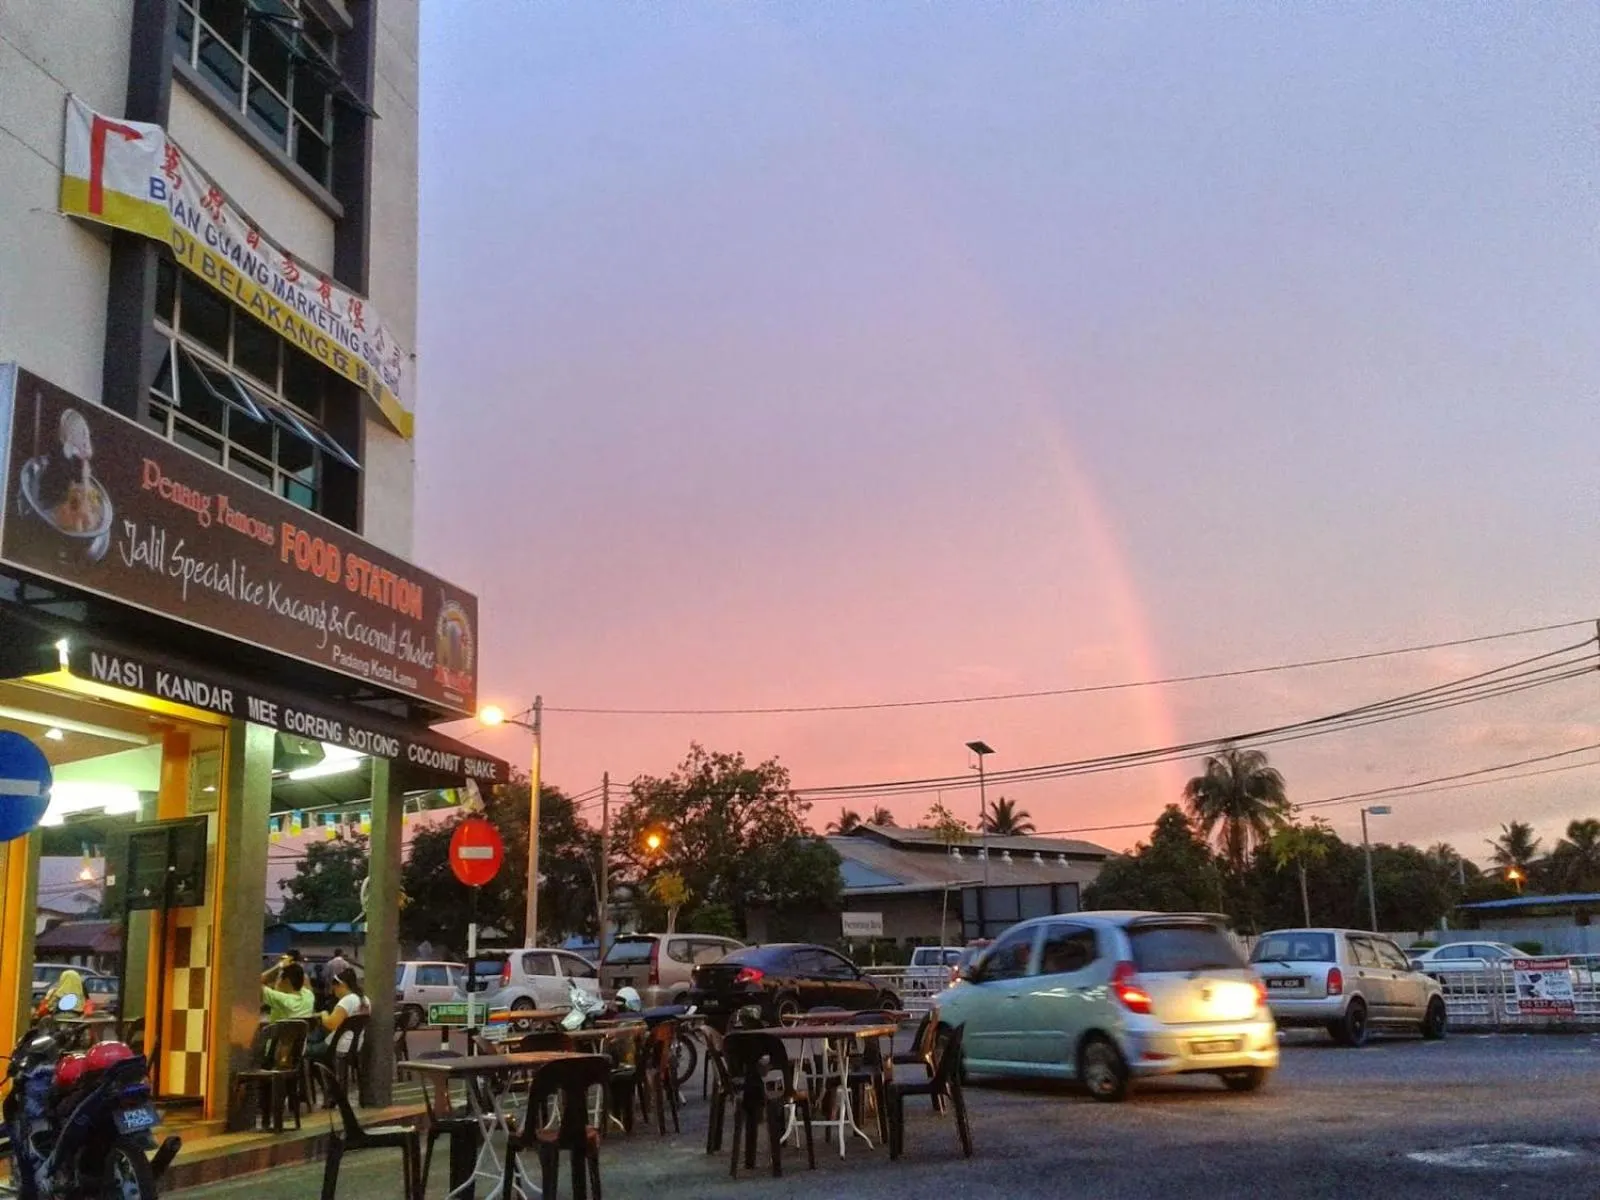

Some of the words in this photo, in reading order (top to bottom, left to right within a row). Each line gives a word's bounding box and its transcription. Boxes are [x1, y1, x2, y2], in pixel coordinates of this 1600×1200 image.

[149, 176, 201, 234] BIAN
[205, 222, 269, 285] GUANG
[272, 273, 360, 352] MARKETING
[172, 227, 195, 265] DI
[202, 252, 329, 360] BELAKANG
[118, 518, 166, 575] Jalil
[169, 539, 237, 602] Special
[266, 580, 328, 650] Kacang
[328, 605, 344, 637] &
[344, 611, 396, 656] Coconut
[142, 458, 212, 528] Penang
[216, 494, 275, 546] Famous
[281, 522, 341, 584] FOOD
[345, 552, 423, 621] STATION
[91, 651, 144, 689] NASI
[156, 671, 234, 713] KANDAR
[248, 696, 278, 727] MEE
[285, 708, 342, 742] GORENG
[348, 727, 400, 757] SOTONG
[407, 743, 461, 774] COCONUT
[464, 757, 496, 779] SHAKE
[332, 644, 370, 677] Padang
[371, 658, 393, 681] Kota
